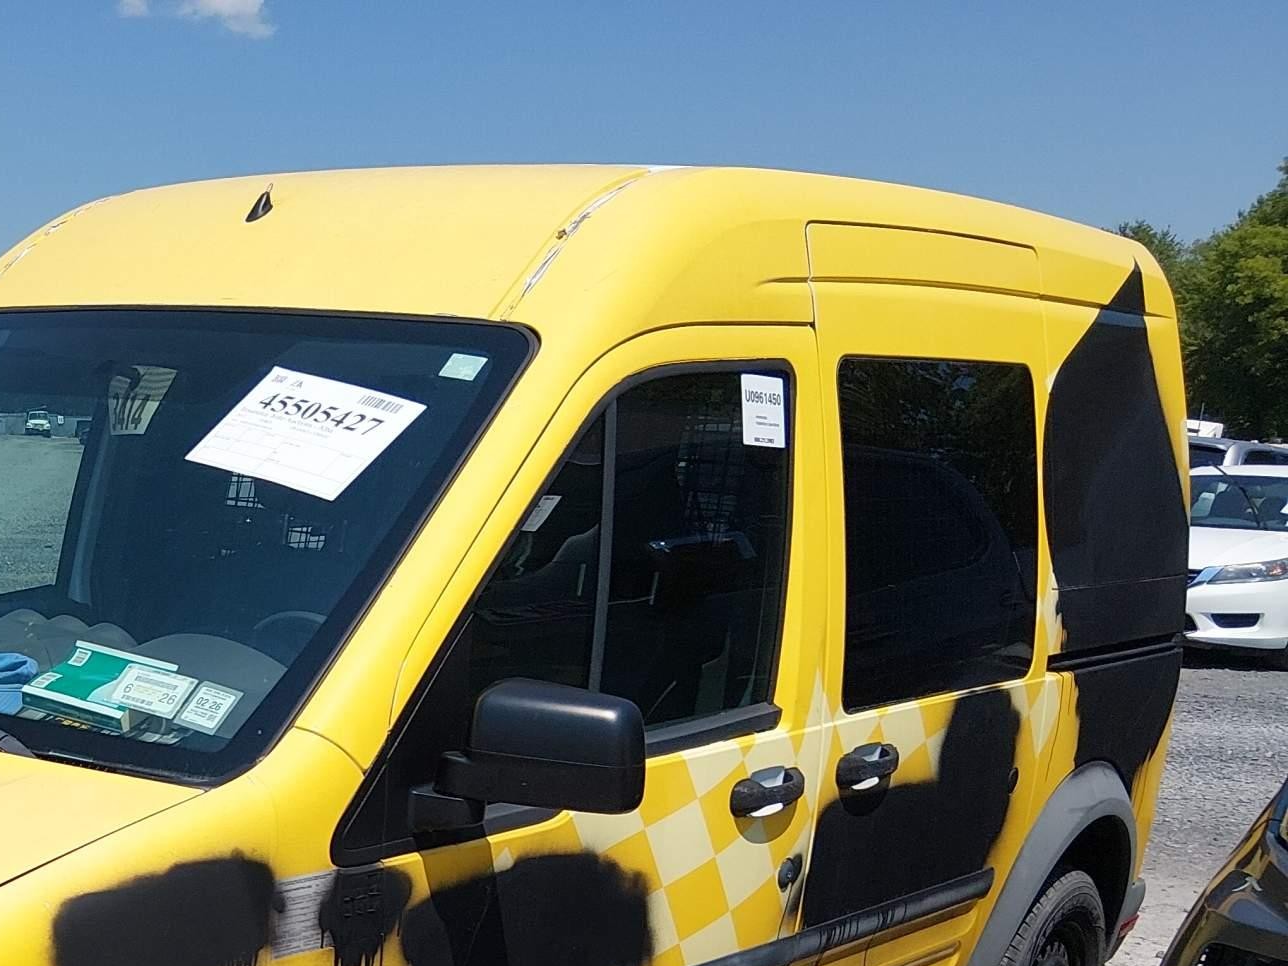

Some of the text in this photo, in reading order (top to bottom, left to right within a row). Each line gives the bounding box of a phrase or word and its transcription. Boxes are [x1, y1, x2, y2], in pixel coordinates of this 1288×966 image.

[744, 389, 781, 406] U0961450
[259, 393, 385, 436] 45505427
[123, 683, 134, 694] 6
[158, 692, 177, 706] 26
[196, 696, 224, 711] 02 26
